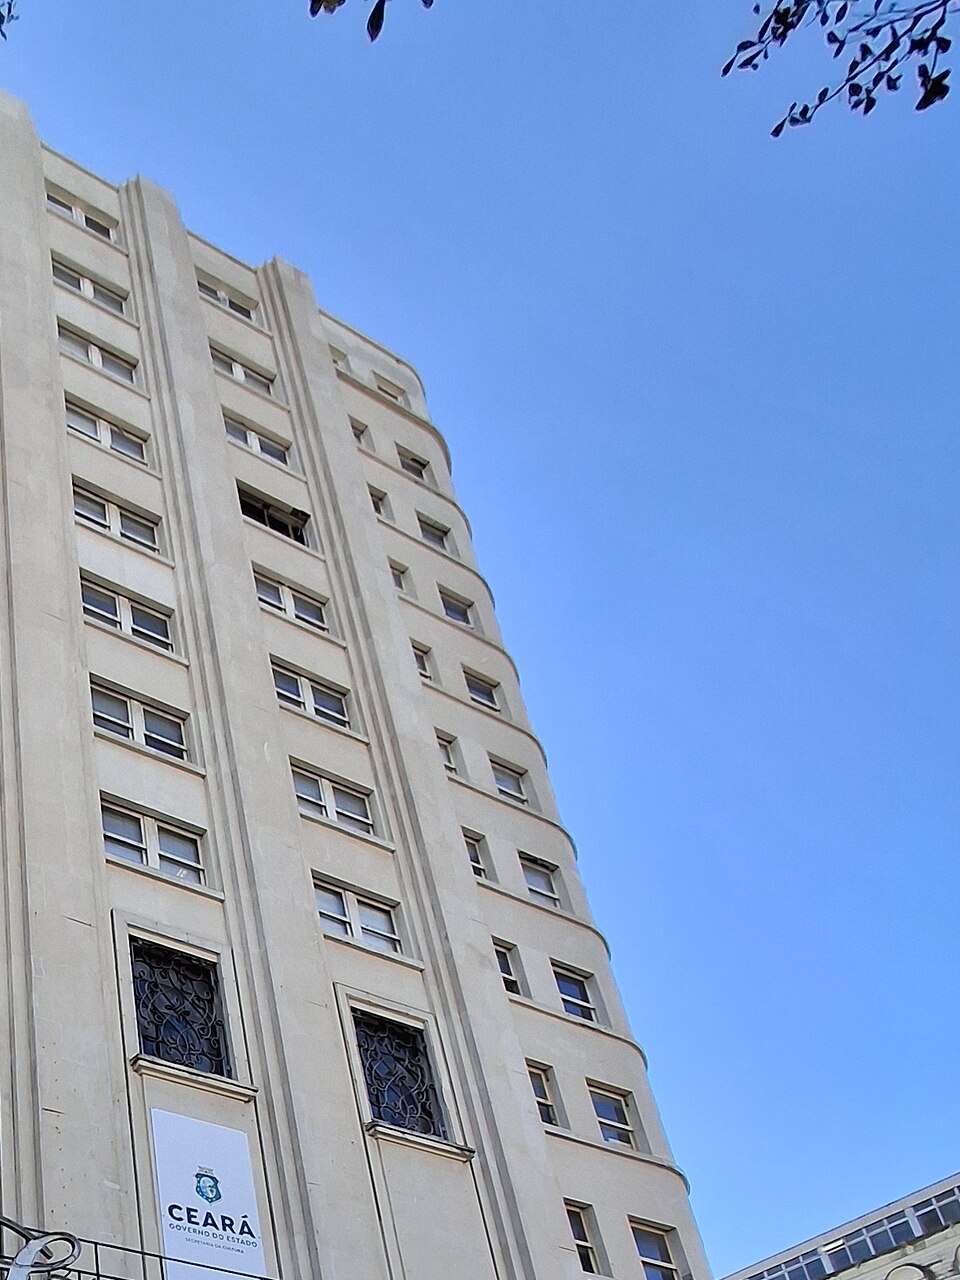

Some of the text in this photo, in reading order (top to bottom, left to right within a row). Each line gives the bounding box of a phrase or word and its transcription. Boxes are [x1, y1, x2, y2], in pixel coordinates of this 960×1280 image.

[167, 1203, 257, 1239] CEARÁ
[168, 1223, 258, 1248] GOVERNO DO ESTADO
